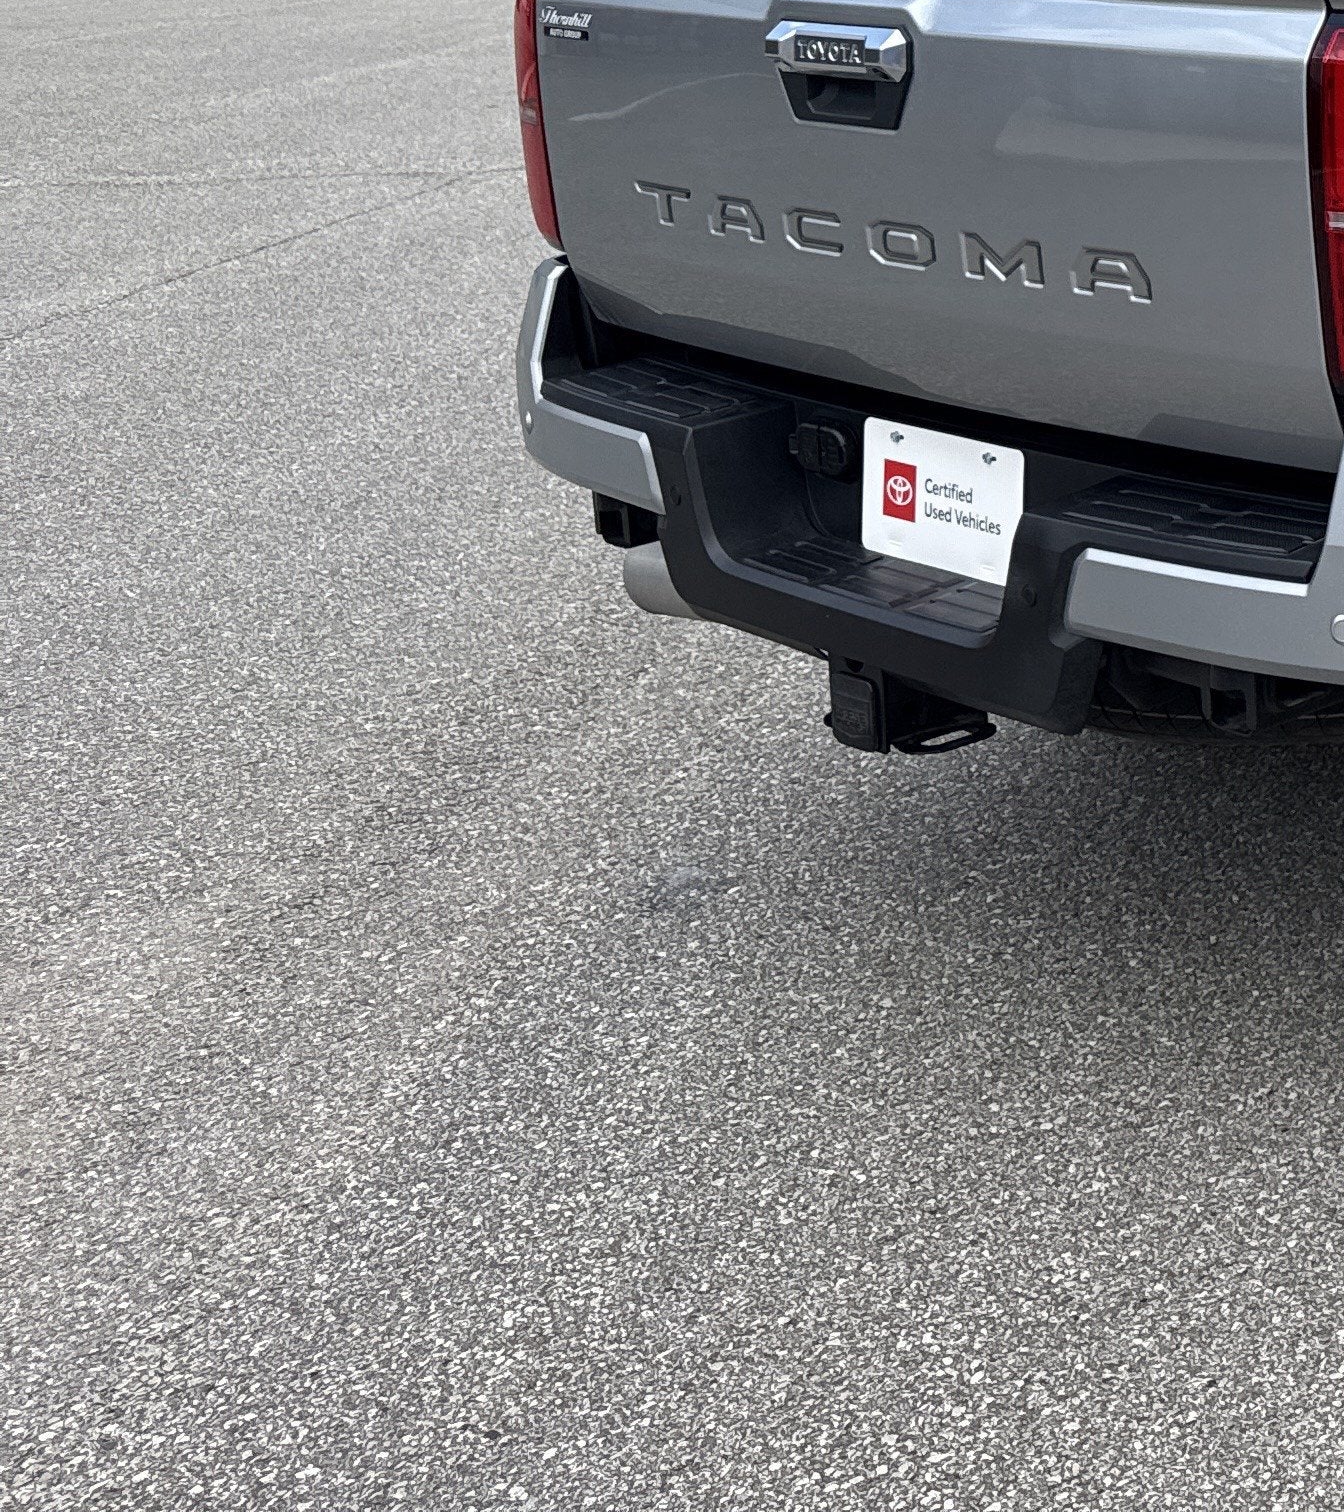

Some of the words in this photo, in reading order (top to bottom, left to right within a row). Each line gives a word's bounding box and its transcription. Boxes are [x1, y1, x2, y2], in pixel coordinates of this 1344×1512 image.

[797, 39, 862, 64] TOYOTA
[634, 179, 1153, 304] TACOMA
[924, 477, 974, 505] Certified
[924, 501, 953, 524] Used
[954, 508, 1002, 536] Vehicles
